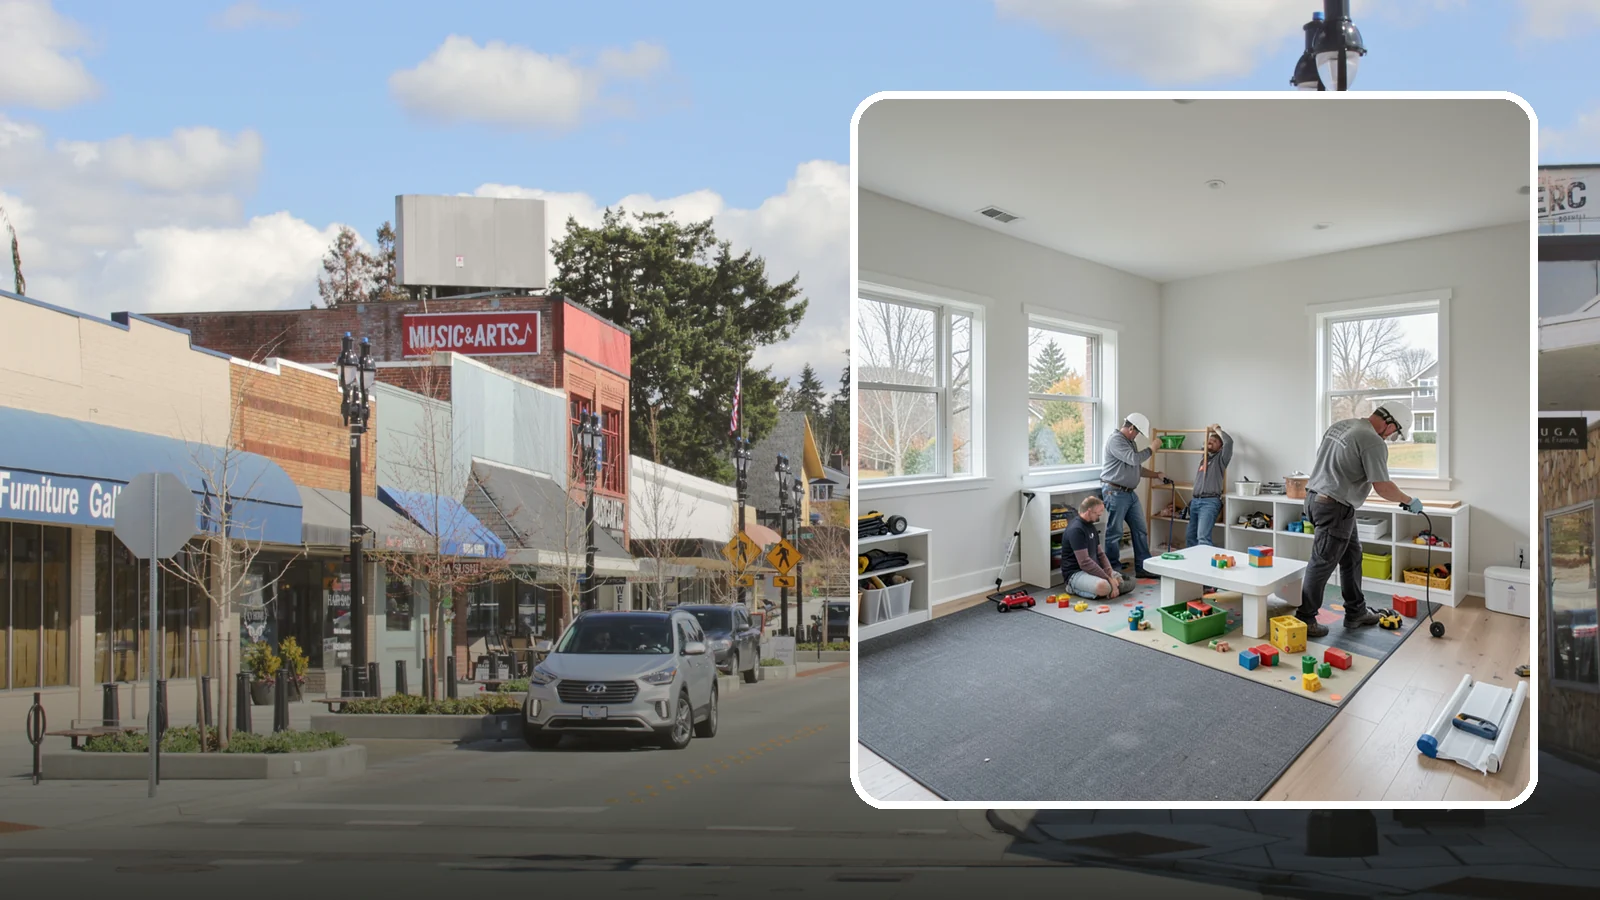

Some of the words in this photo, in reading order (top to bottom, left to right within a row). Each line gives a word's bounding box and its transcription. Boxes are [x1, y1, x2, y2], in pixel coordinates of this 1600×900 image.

[408, 322, 520, 349] MUSIC&ARTS
[0, 471, 80, 515] Furniture
[453, 563, 480, 575] SUSHI
